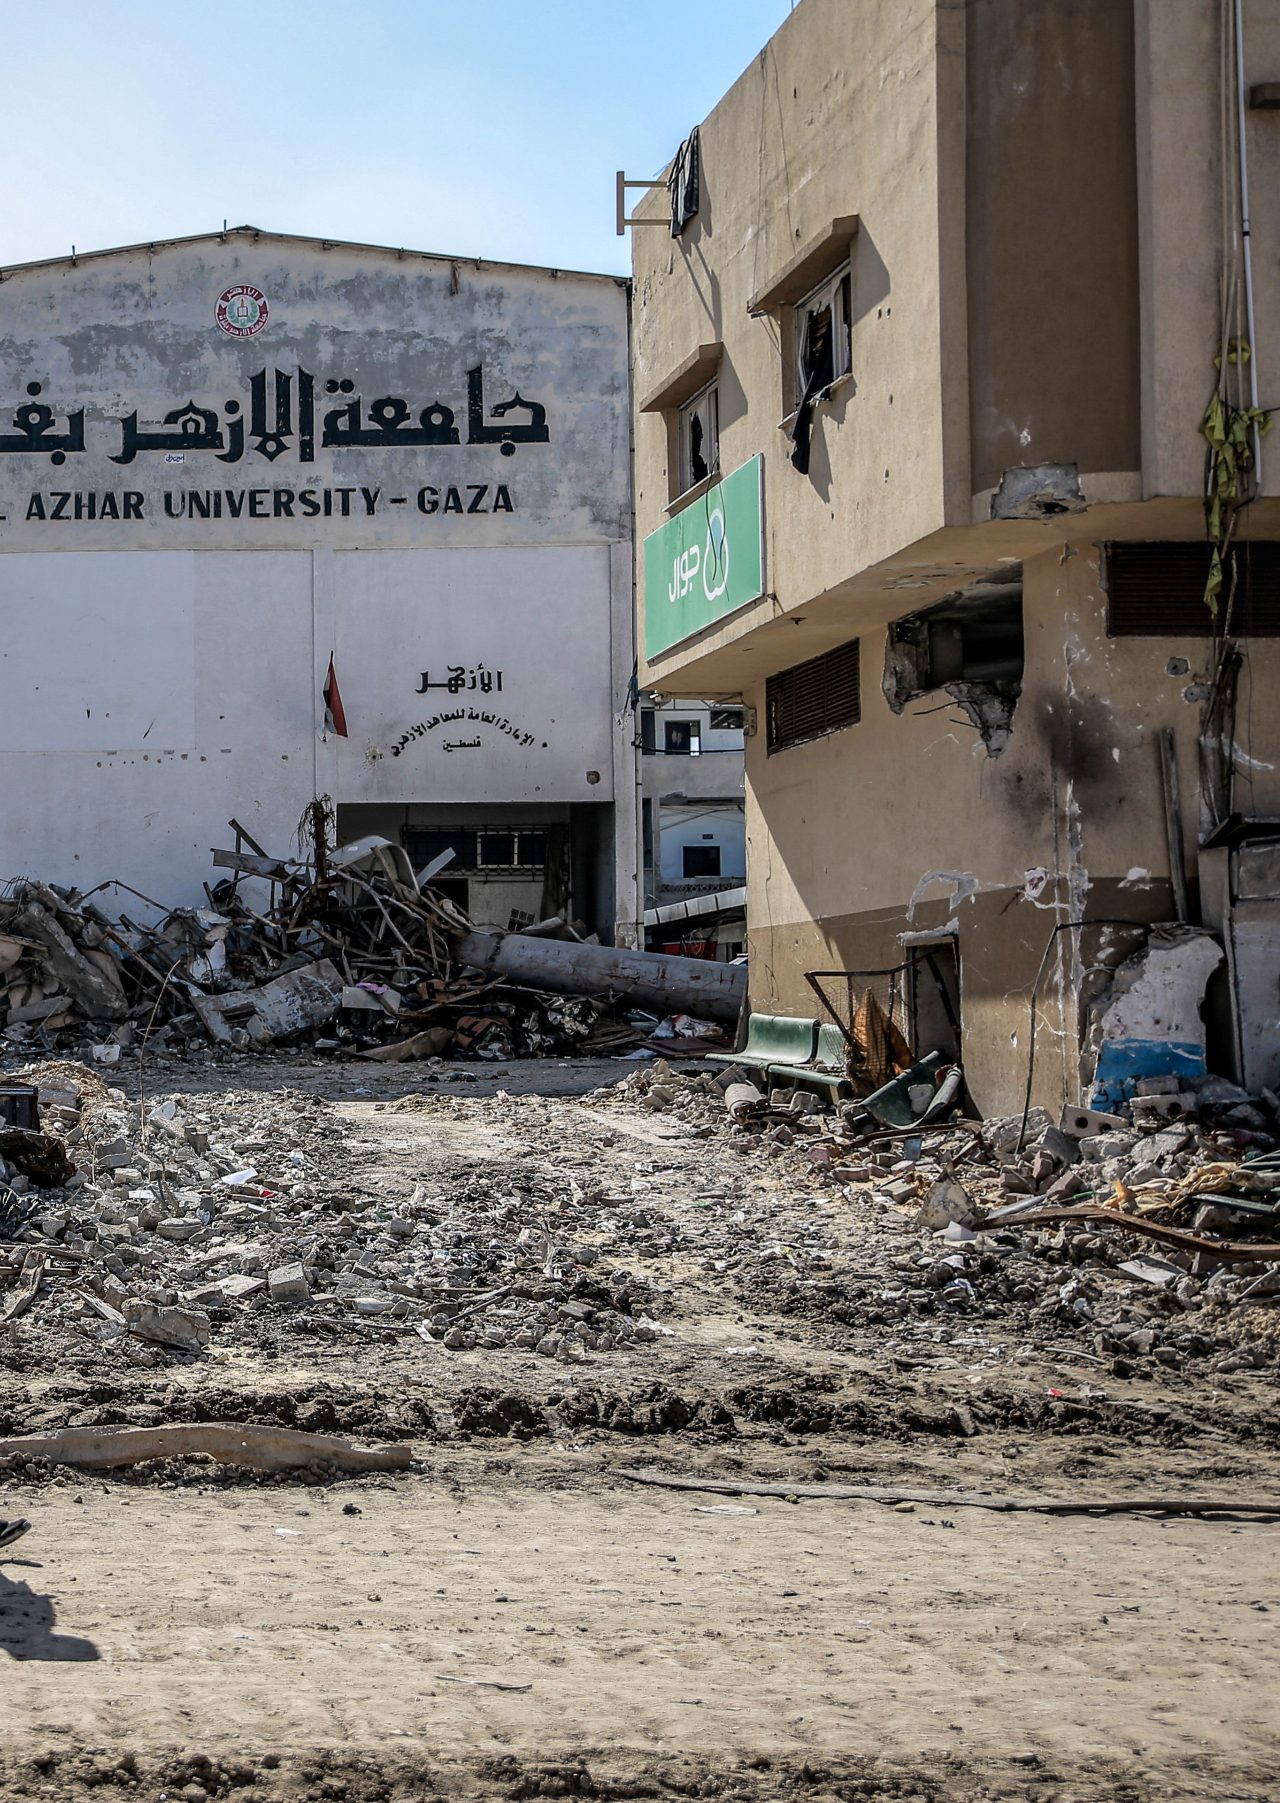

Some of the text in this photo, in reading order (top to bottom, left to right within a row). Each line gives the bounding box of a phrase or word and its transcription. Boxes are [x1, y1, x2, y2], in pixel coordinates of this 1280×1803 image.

[321, 362, 550, 457] جامعة
[25, 491, 145, 521] AZHAR
[164, 487, 381, 519] UNIVERSITY
[418, 484, 514, 514] GAZA
[668, 544, 700, 602] جوال
[415, 663, 503, 694] الأزهر
[426, 708, 466, 730] للمعاهد
[442, 735, 482, 752] فلسطين
